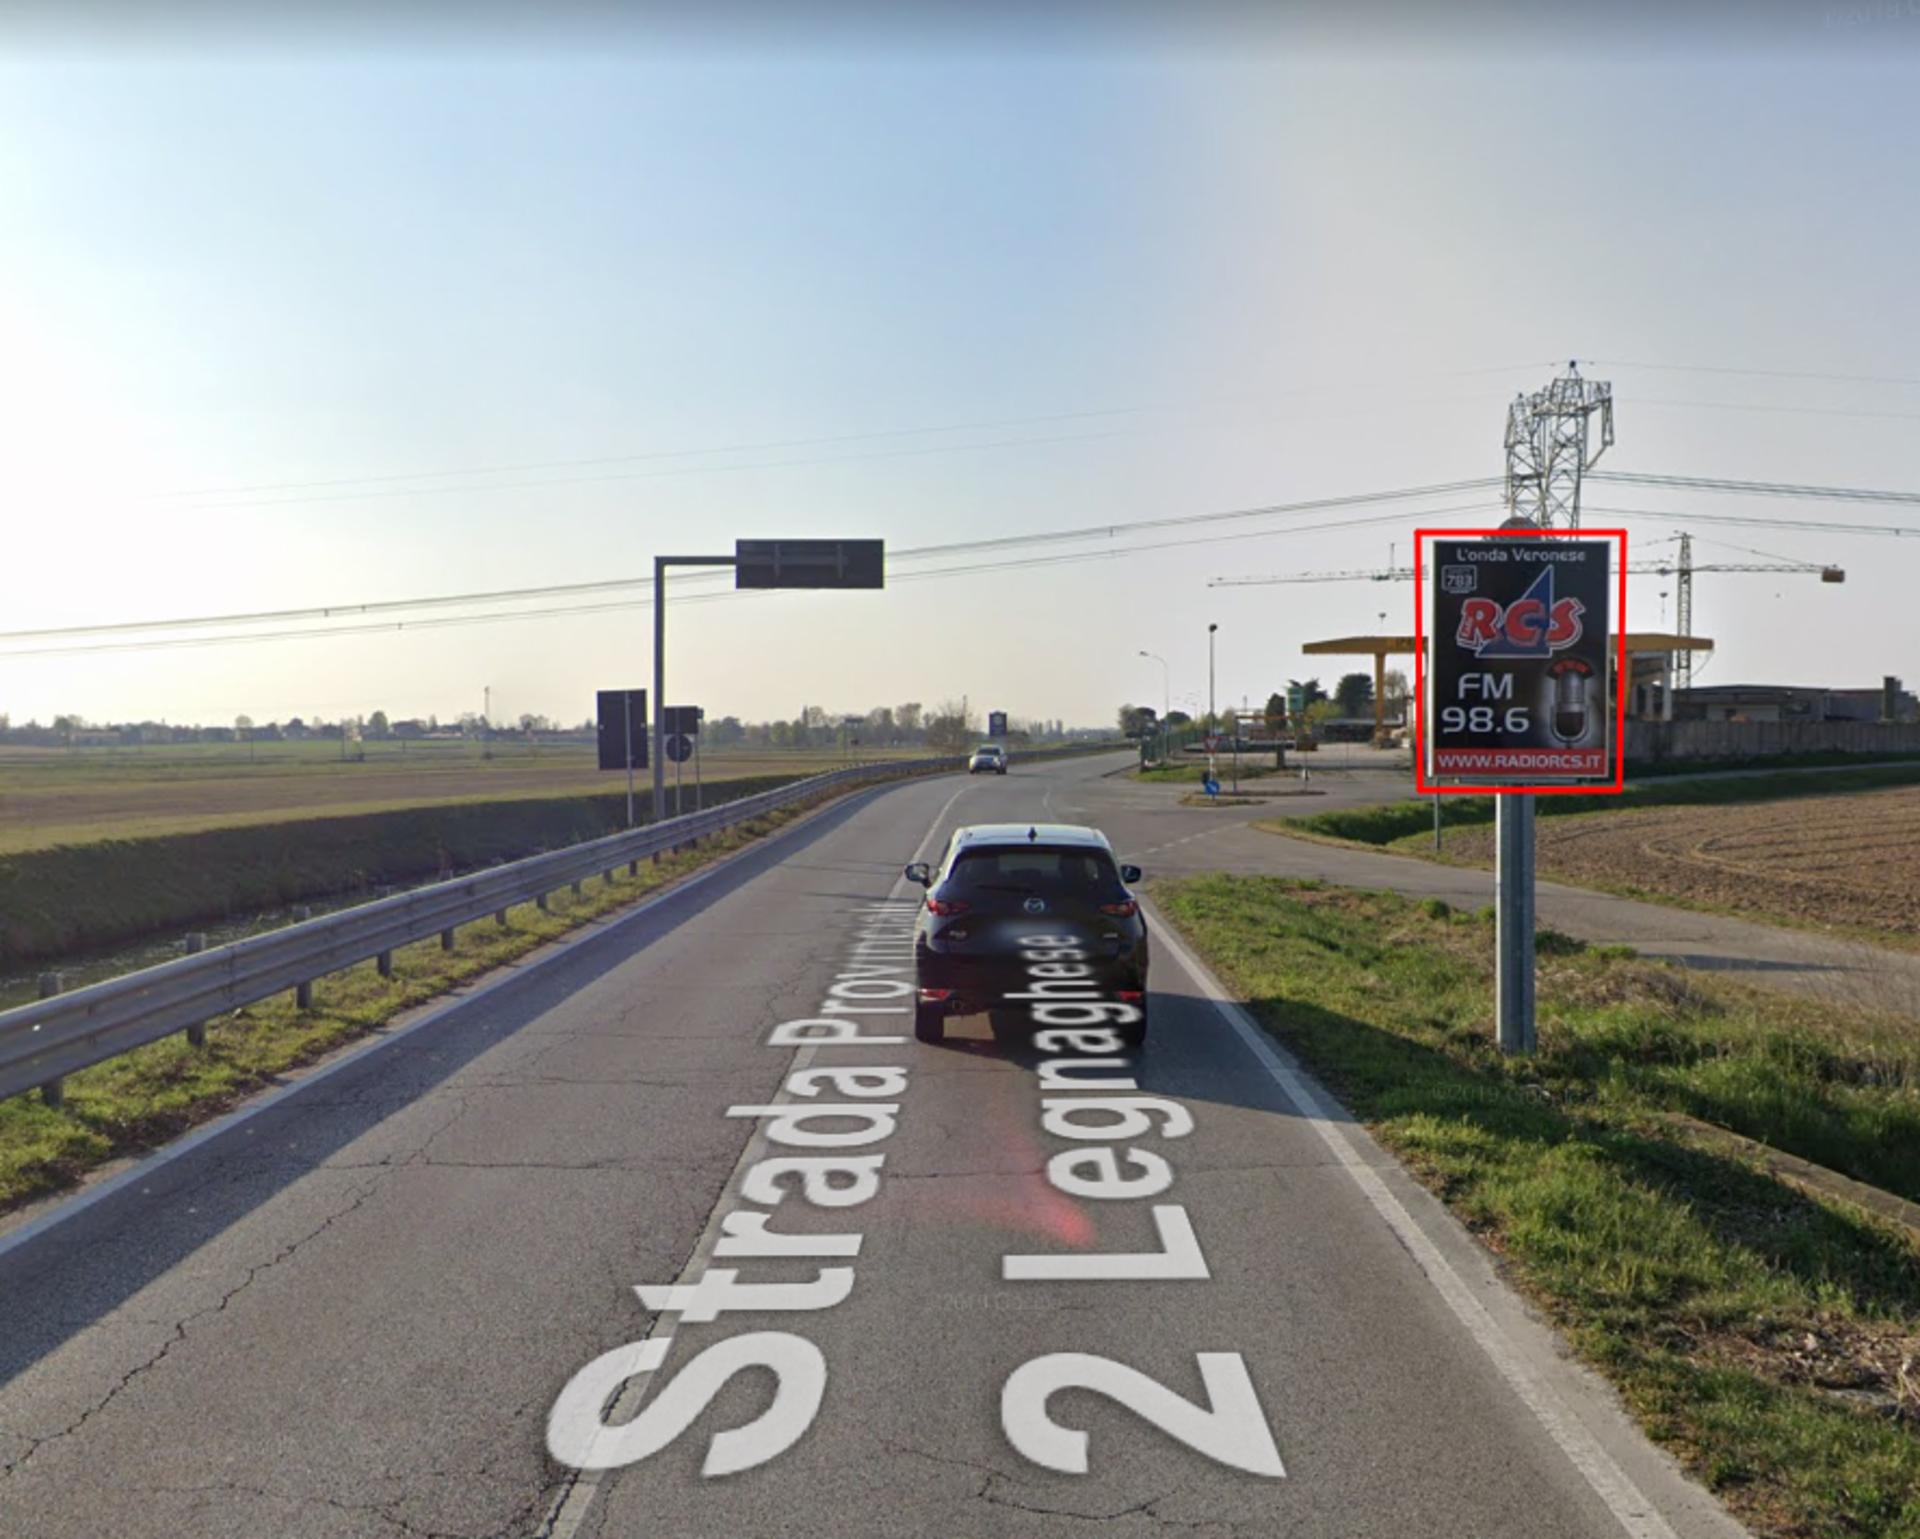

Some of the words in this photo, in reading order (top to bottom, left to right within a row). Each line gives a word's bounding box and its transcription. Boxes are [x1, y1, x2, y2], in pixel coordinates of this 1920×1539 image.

[1456, 548, 1507, 562] L'onda
[1512, 548, 1587, 562] Veronese
[1456, 597, 1585, 650] RCS
[1458, 673, 1513, 699] FM
[1441, 706, 1530, 734] 98.6
[1438, 754, 1601, 769] WWW.RADIORCS.IT
